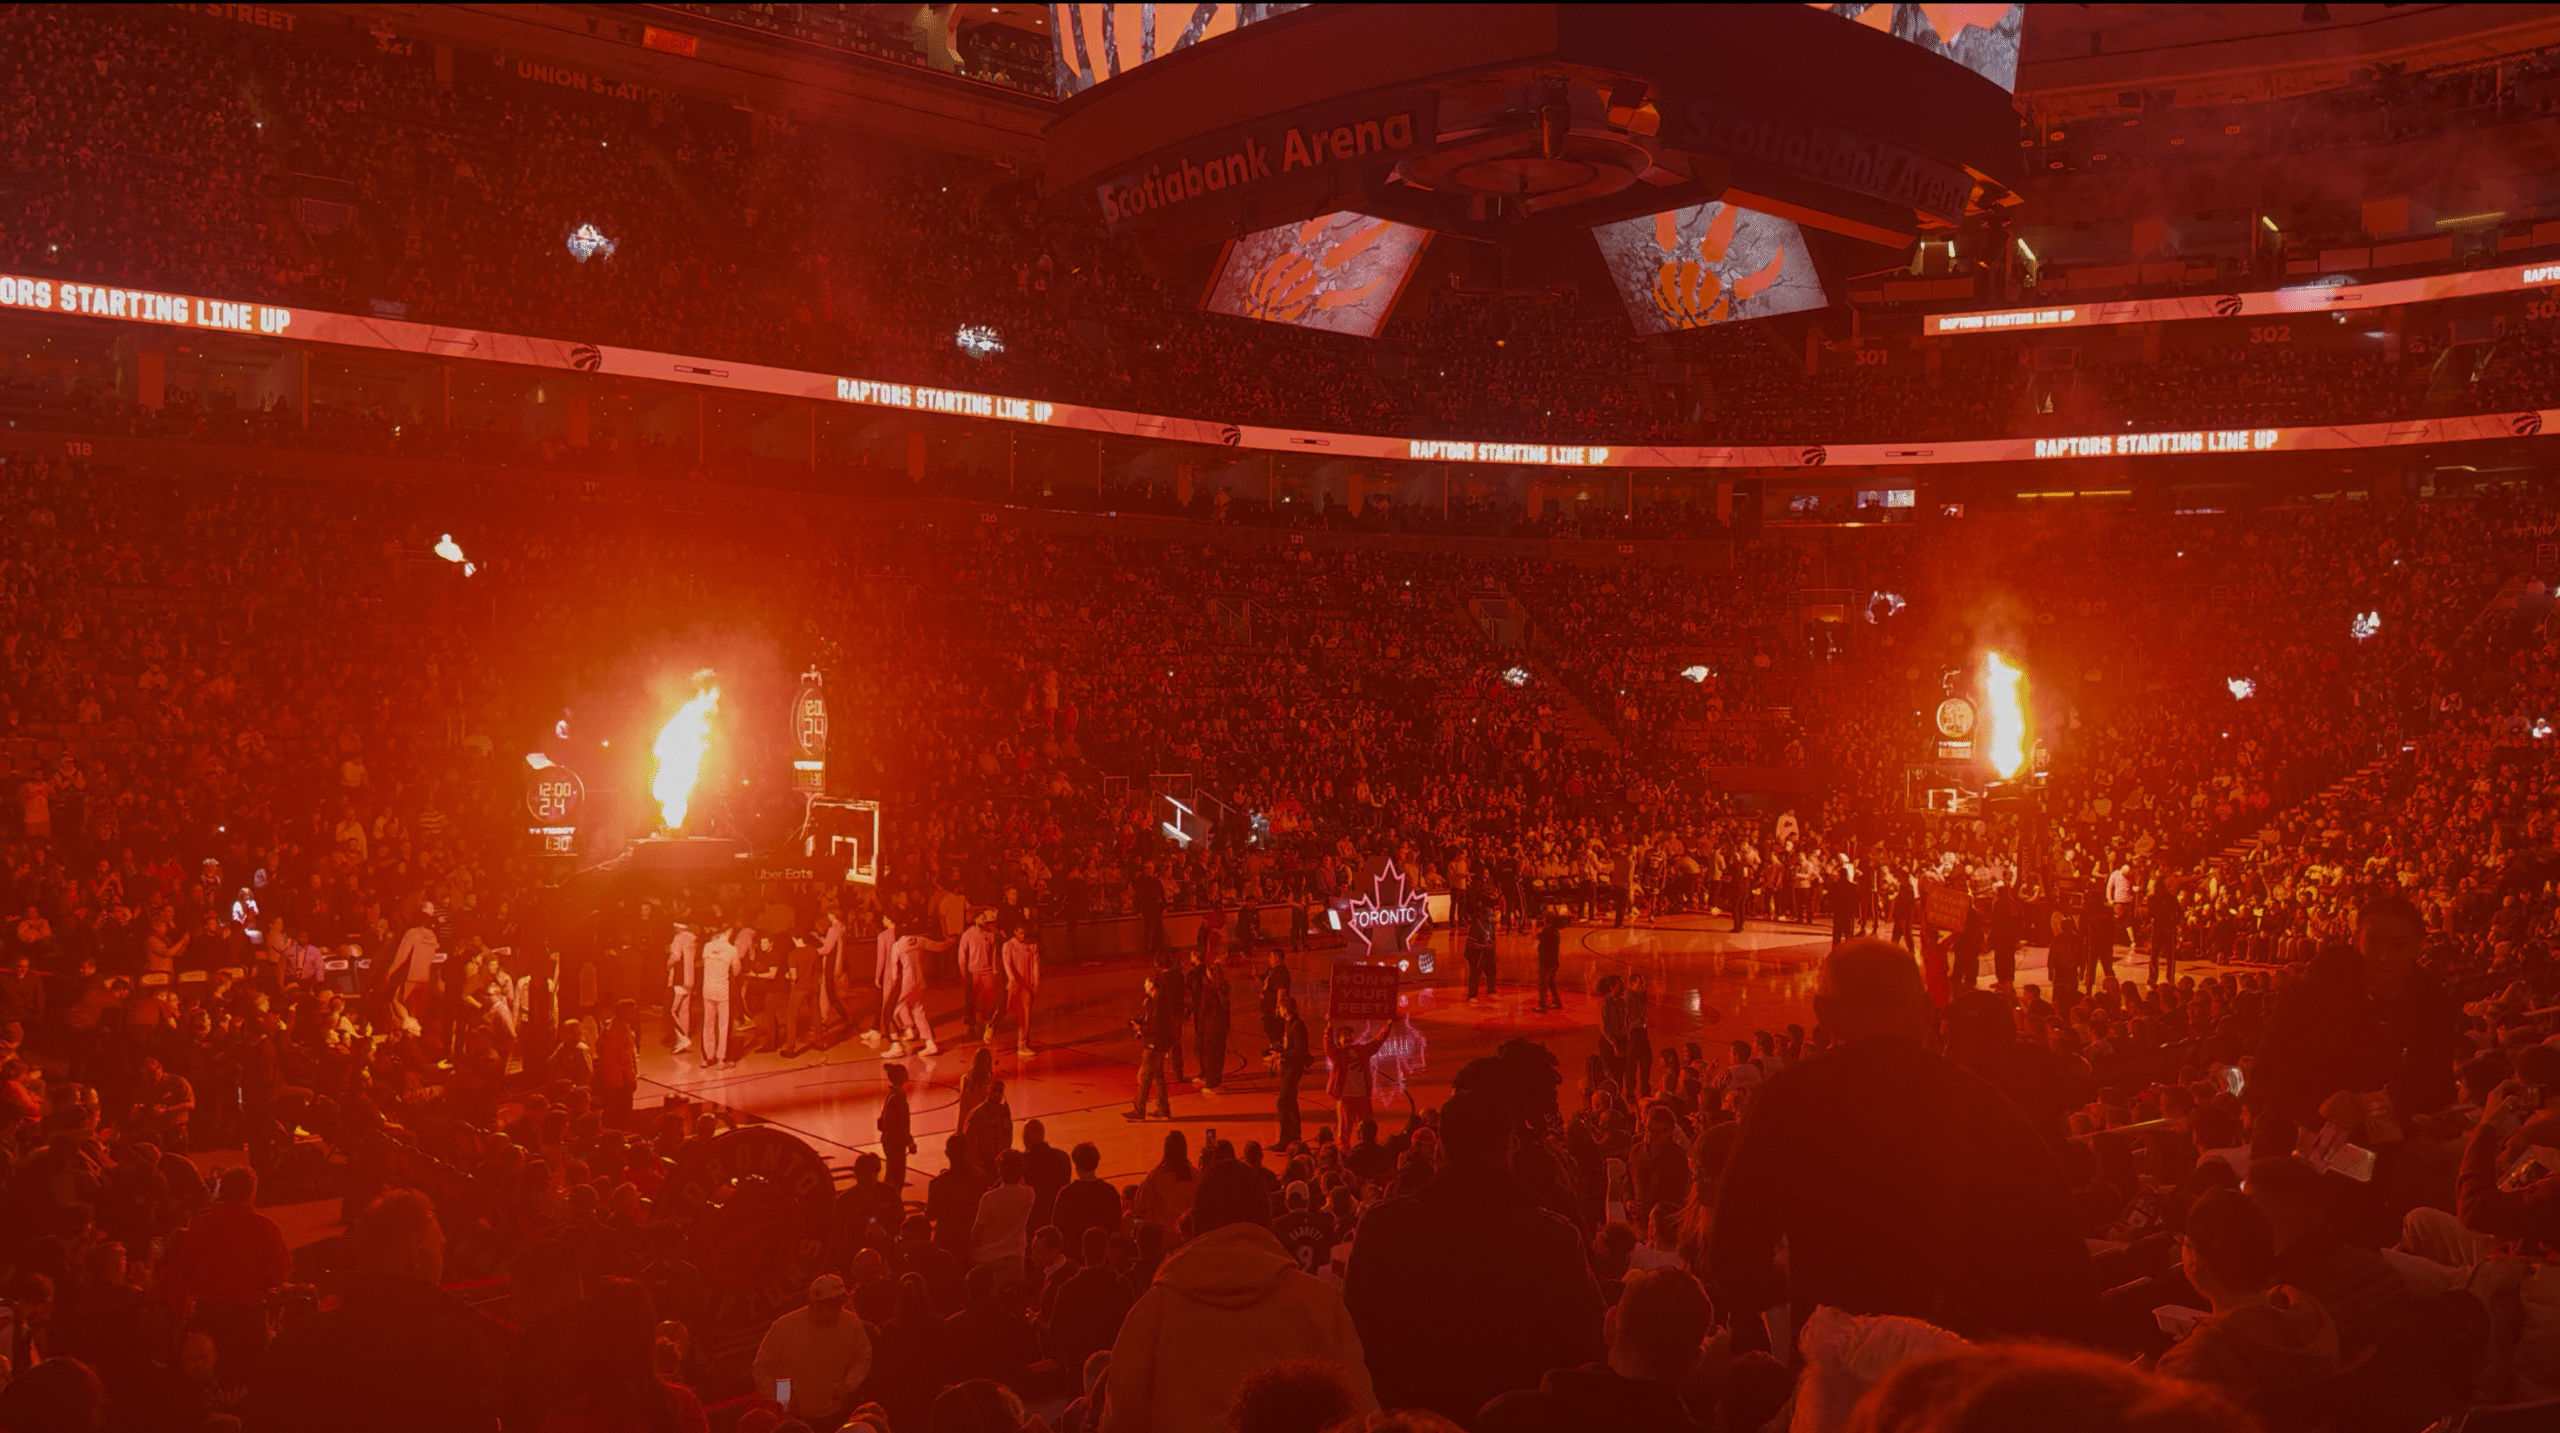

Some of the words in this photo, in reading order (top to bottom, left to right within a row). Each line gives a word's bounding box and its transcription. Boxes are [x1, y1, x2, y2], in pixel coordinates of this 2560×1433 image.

[206, 4, 298, 31] STREET
[517, 61, 587, 91] UNION
[1682, 101, 1894, 192] Scotiabank
[1101, 138, 1272, 224] Scotiabank
[1283, 112, 1413, 172] Arena
[0, 276, 52, 308] ORS
[60, 284, 188, 323] STARTING
[197, 299, 252, 331] LINE
[259, 307, 291, 334] UP
[2249, 324, 2292, 344] 302
[1854, 349, 1888, 366] 301
[837, 378, 912, 407] RAPTORS
[916, 388, 992, 416] STARTING
[996, 397, 1031, 421] LINE
[1034, 402, 1054, 423] UP
[66, 441, 92, 456] 118
[1410, 440, 1475, 460] RAPTORS
[1478, 443, 1548, 463] STARTING
[1551, 446, 1585, 465] LINE
[1588, 446, 1609, 465] UP
[2034, 437, 2112, 458] RAPTORS
[2117, 433, 2204, 454] STARTING
[2208, 430, 2249, 451] LINE
[2254, 429, 2279, 450] UP
[980, 512, 998, 524] 120
[539, 782, 572, 797] 12:00
[539, 798, 566, 816] 24
[754, 868, 783, 881] Uber
[784, 867, 814, 880] Eats
[1354, 907, 1417, 928] TORONTO
[1353, 974, 1380, 986] ON
[1298, 1245, 1313, 1272] 9
